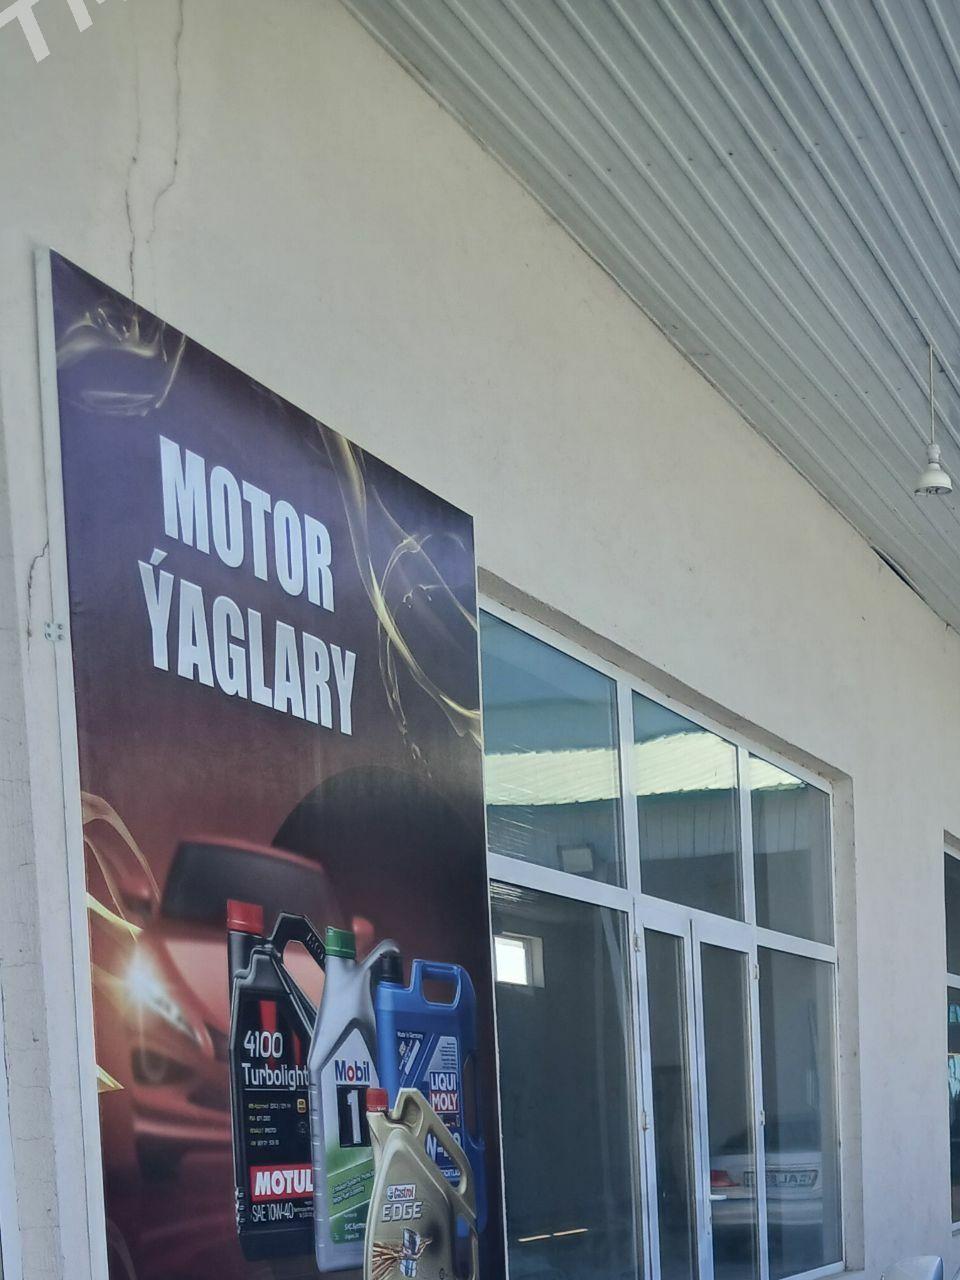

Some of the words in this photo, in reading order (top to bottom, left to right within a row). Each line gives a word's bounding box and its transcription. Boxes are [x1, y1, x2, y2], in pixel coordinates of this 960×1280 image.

[159, 434, 335, 613] MOTOR
[137, 548, 357, 736] ÝAGLARY
[244, 1030, 283, 1058] 4100
[241, 1062, 310, 1091] Turbolight
[335, 1060, 370, 1082] Mobil
[430, 1072, 457, 1091] LIQUI
[431, 1092, 458, 1111] MOLY
[347, 1089, 361, 1144] 1
[254, 1168, 314, 1196] MOTUL
[252, 1204, 267, 1222] SAE
[382, 1201, 423, 1222] EDGE
